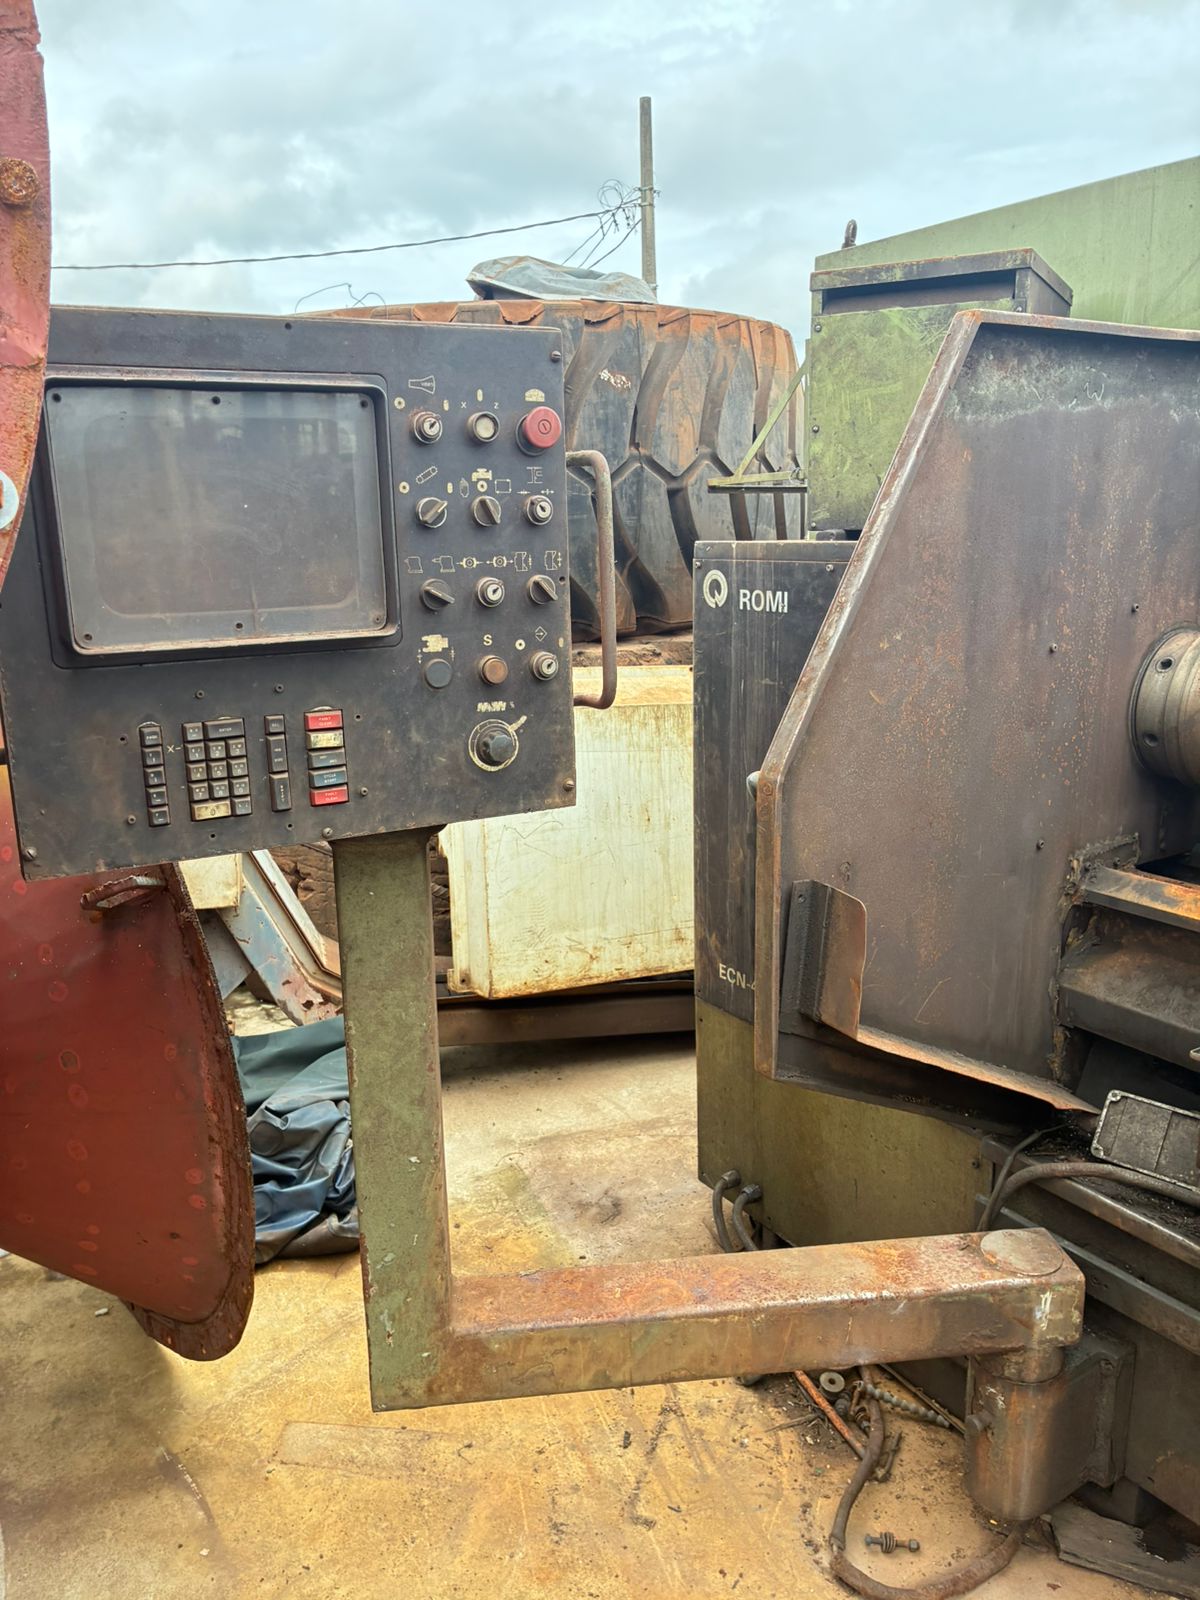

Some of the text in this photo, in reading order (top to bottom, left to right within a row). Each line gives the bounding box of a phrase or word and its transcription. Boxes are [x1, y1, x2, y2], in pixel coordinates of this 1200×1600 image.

[461, 401, 467, 409] X
[739, 589, 788, 613] ROMI
[483, 634, 493, 646] S
